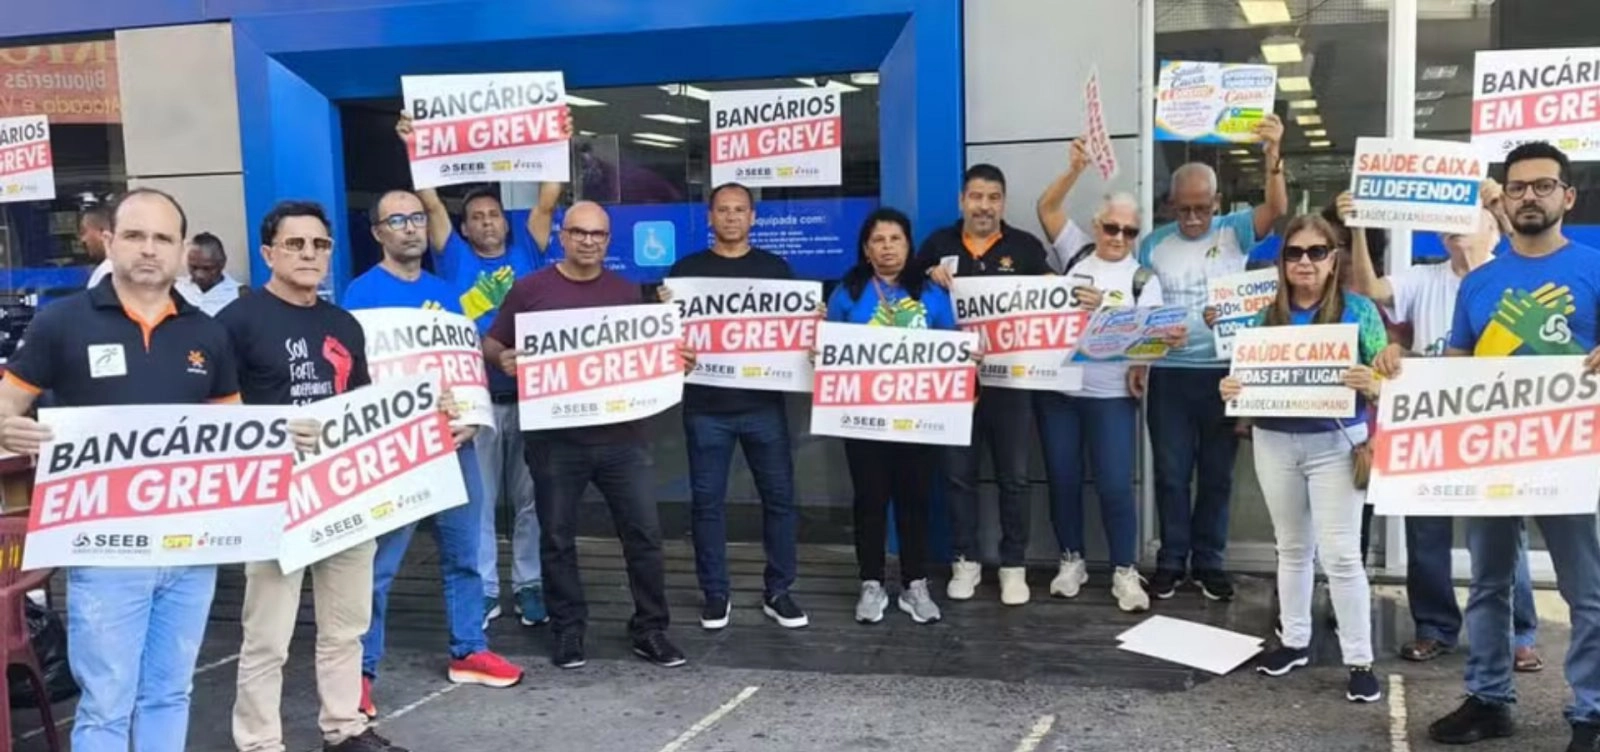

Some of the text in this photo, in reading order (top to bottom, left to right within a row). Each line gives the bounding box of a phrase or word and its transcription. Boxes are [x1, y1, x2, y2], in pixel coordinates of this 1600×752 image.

[413, 81, 558, 120] BANCÁRIOS
[716, 95, 835, 129] BANCÁRIOS
[1480, 98, 1524, 131] EM
[415, 110, 560, 157] EM GREVE
[716, 120, 834, 161] EM GREVE
[452, 162, 485, 173] SEEB
[1358, 148, 1481, 177] SAÚDE CAIXA
[1357, 178, 1471, 202] EU DEFENDO!
[674, 286, 816, 318] BANCÁRIOS
[366, 317, 481, 356] ANCÁRIO
[524, 313, 674, 357] BANCÁRIOS
[721, 319, 814, 350] GREVE
[996, 312, 1080, 350] GREVE
[822, 335, 970, 366] BANCÁRIOS
[1294, 342, 1352, 361] CAIXA
[525, 343, 676, 397] EM GREVE
[820, 370, 969, 403] EM GREVE
[1270, 368, 1290, 383] EM
[1392, 371, 1599, 423] BANCÁRIOS
[48, 416, 288, 474] BANCÁRIOS
[328, 417, 443, 497] GREVE
[1388, 410, 1596, 472] EM GREVE
[39, 458, 283, 525] EM GREVE
[95, 534, 150, 547] SEEB
[324, 513, 363, 537] SEEB
